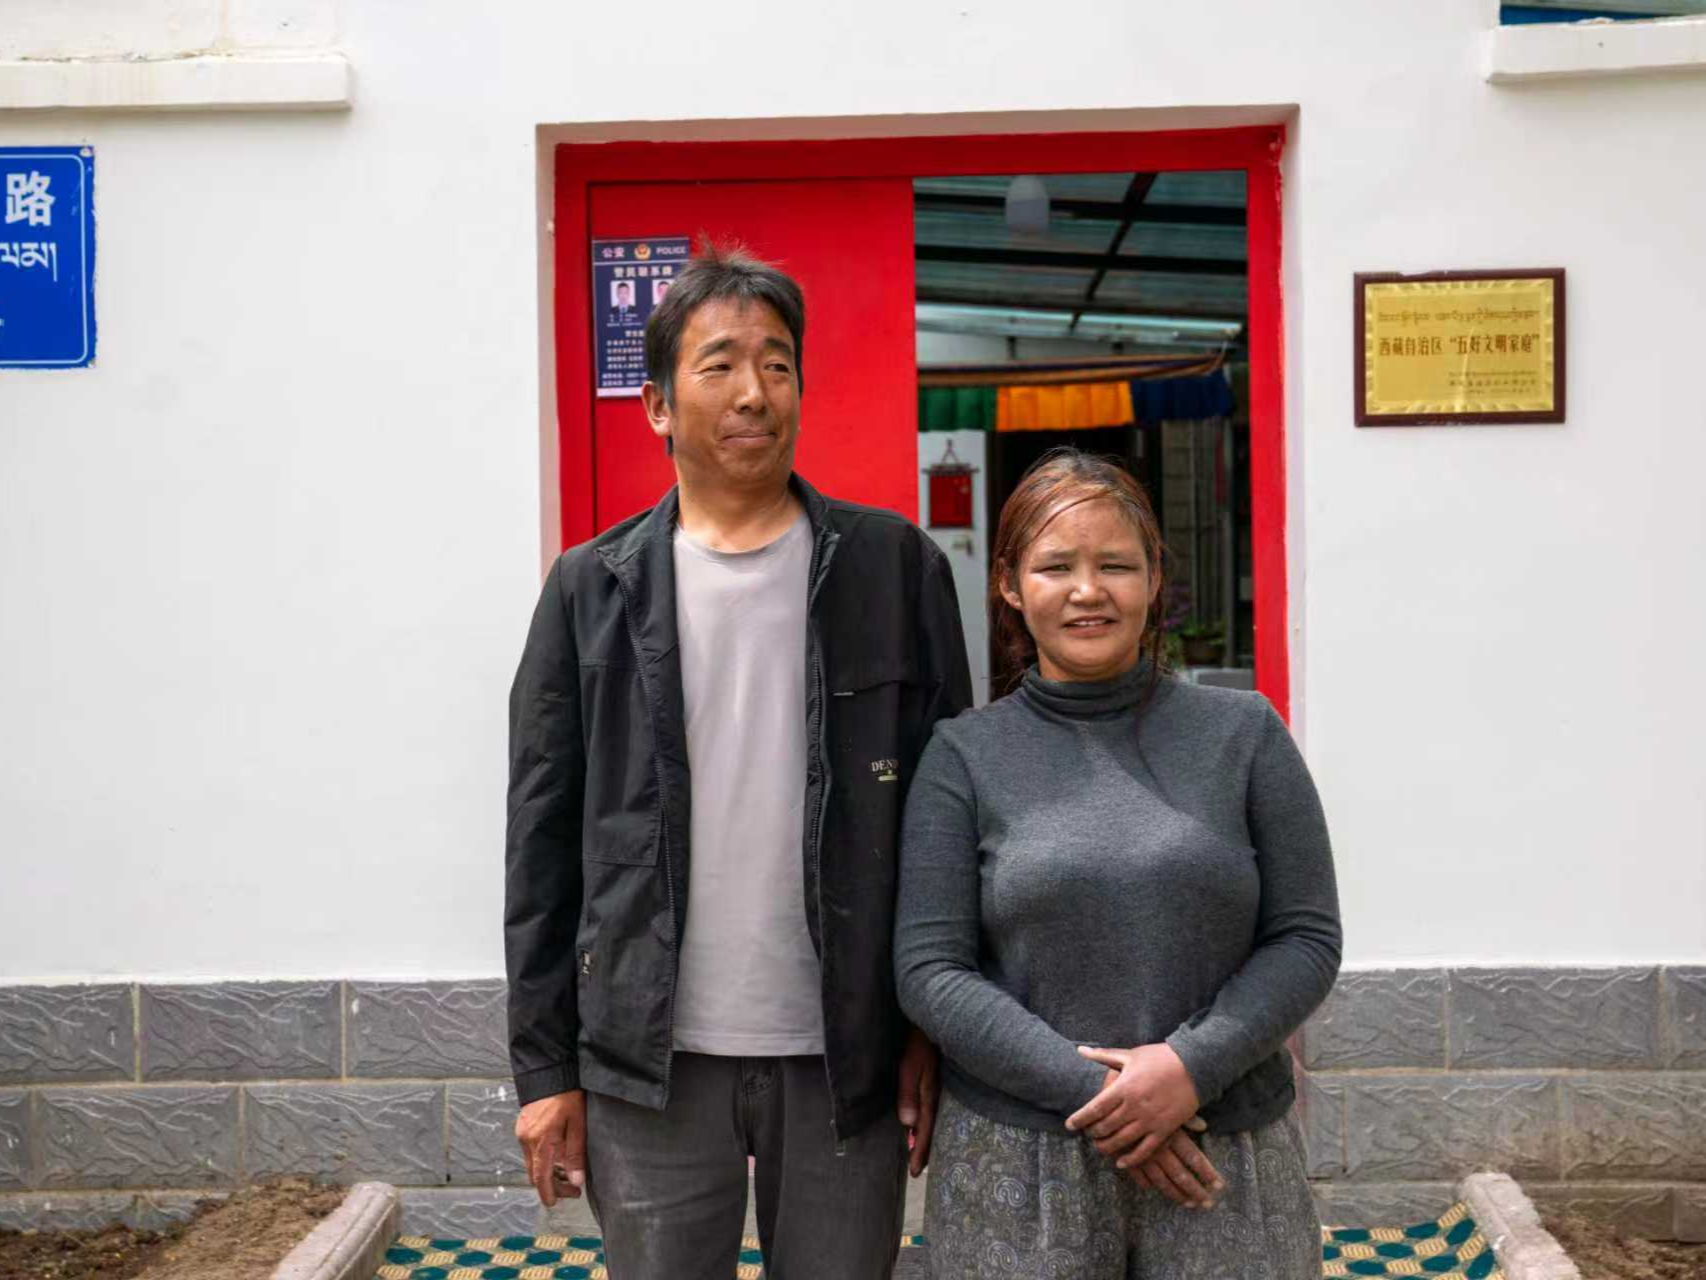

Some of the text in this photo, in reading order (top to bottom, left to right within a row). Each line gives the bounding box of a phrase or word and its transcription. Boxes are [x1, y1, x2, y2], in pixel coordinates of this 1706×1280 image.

[5, 171, 55, 226] 路
[602, 247, 625, 258] 公安
[657, 246, 685, 255] POLICE
[1379, 333, 1540, 356] 西藏自治区 “五好文明家庭”
